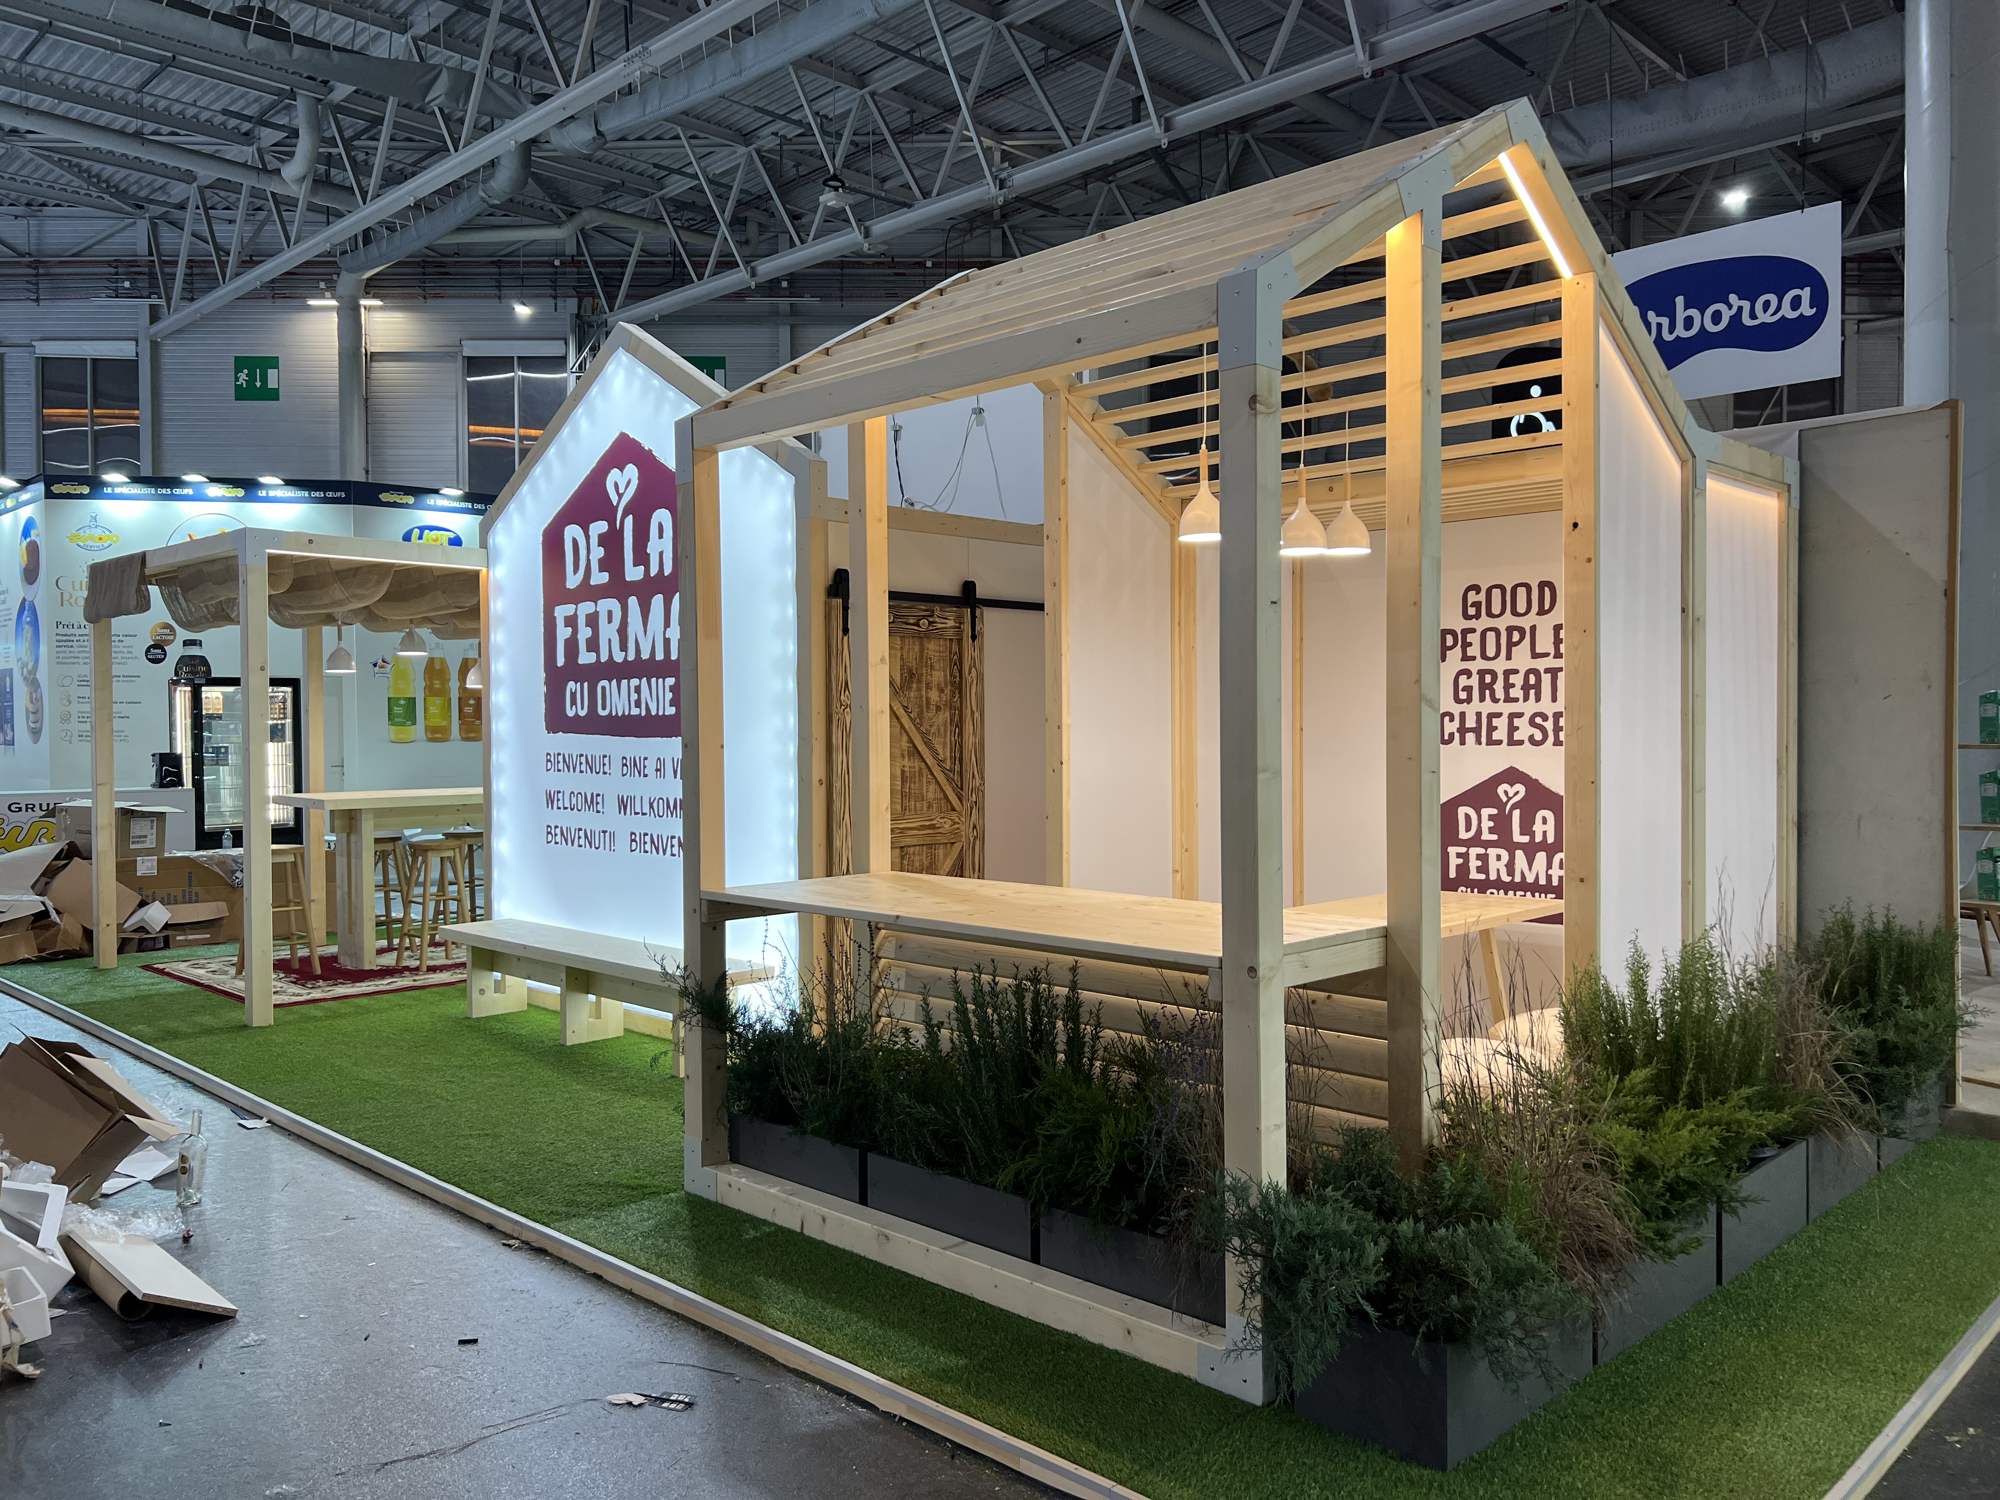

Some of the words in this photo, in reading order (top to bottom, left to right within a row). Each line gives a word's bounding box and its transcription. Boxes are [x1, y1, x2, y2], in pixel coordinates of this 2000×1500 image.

[1636, 286, 1816, 343] rborea
[268, 488, 309, 497] SPÉCIALISTE
[563, 519, 610, 589] DE
[623, 507, 673, 582] LA
[1461, 580, 1558, 621] GOOD
[1440, 623, 1564, 663] PEOPLE
[565, 680, 589, 717] CU
[596, 676, 676, 717] OMENIE
[1452, 666, 1564, 705] GREAT
[1440, 710, 1564, 747] CHEESE
[545, 751, 612, 776] BIENVENUE!
[621, 755, 649, 779] BINE
[654, 756, 666, 780] AI
[7, 801, 63, 813] GRU
[545, 788, 605, 815] WELCOME!
[545, 824, 616, 852] BENVENUTI!
[1457, 805, 1499, 841] DE
[1511, 808, 1556, 844] LA
[1447, 846, 1565, 886] FERMA
